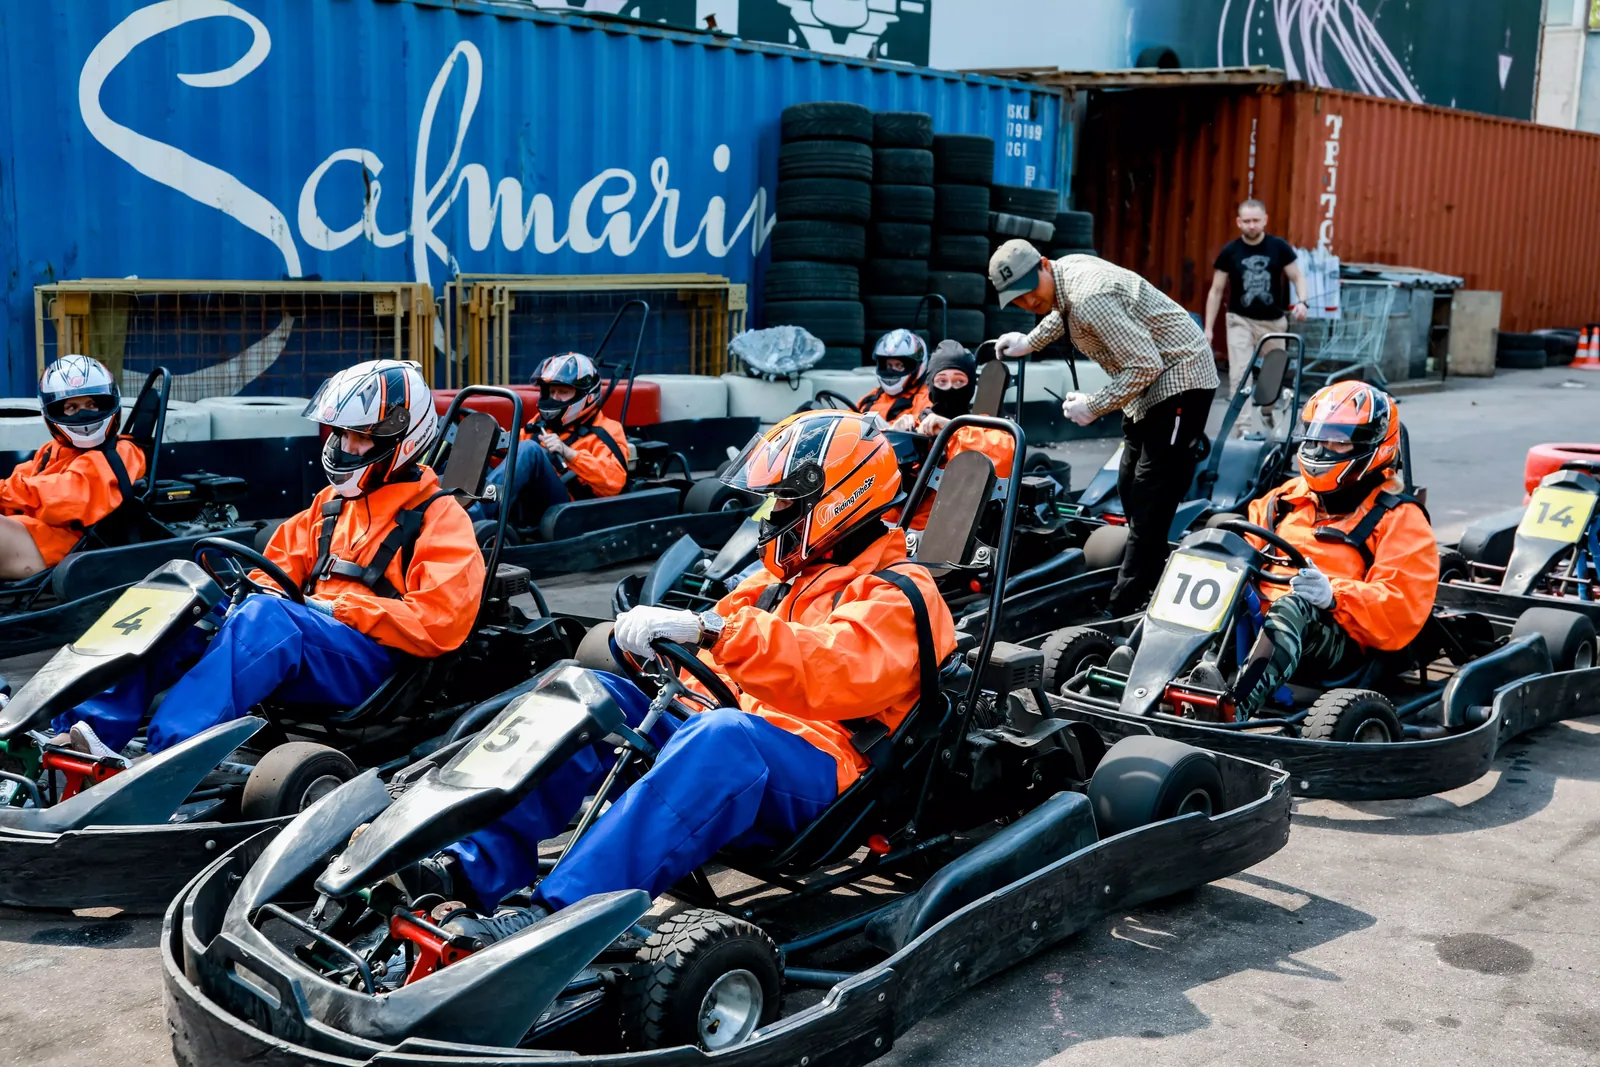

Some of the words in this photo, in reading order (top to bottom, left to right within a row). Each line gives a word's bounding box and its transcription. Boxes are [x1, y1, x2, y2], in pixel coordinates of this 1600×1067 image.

[999, 265, 1014, 282] 13
[834, 496, 856, 516] Riding
[852, 484, 869, 500] Tribe
[1536, 501, 1575, 528] 14
[1172, 572, 1221, 611] 10
[112, 606, 152, 636] 4
[482, 715, 530, 753] 5
